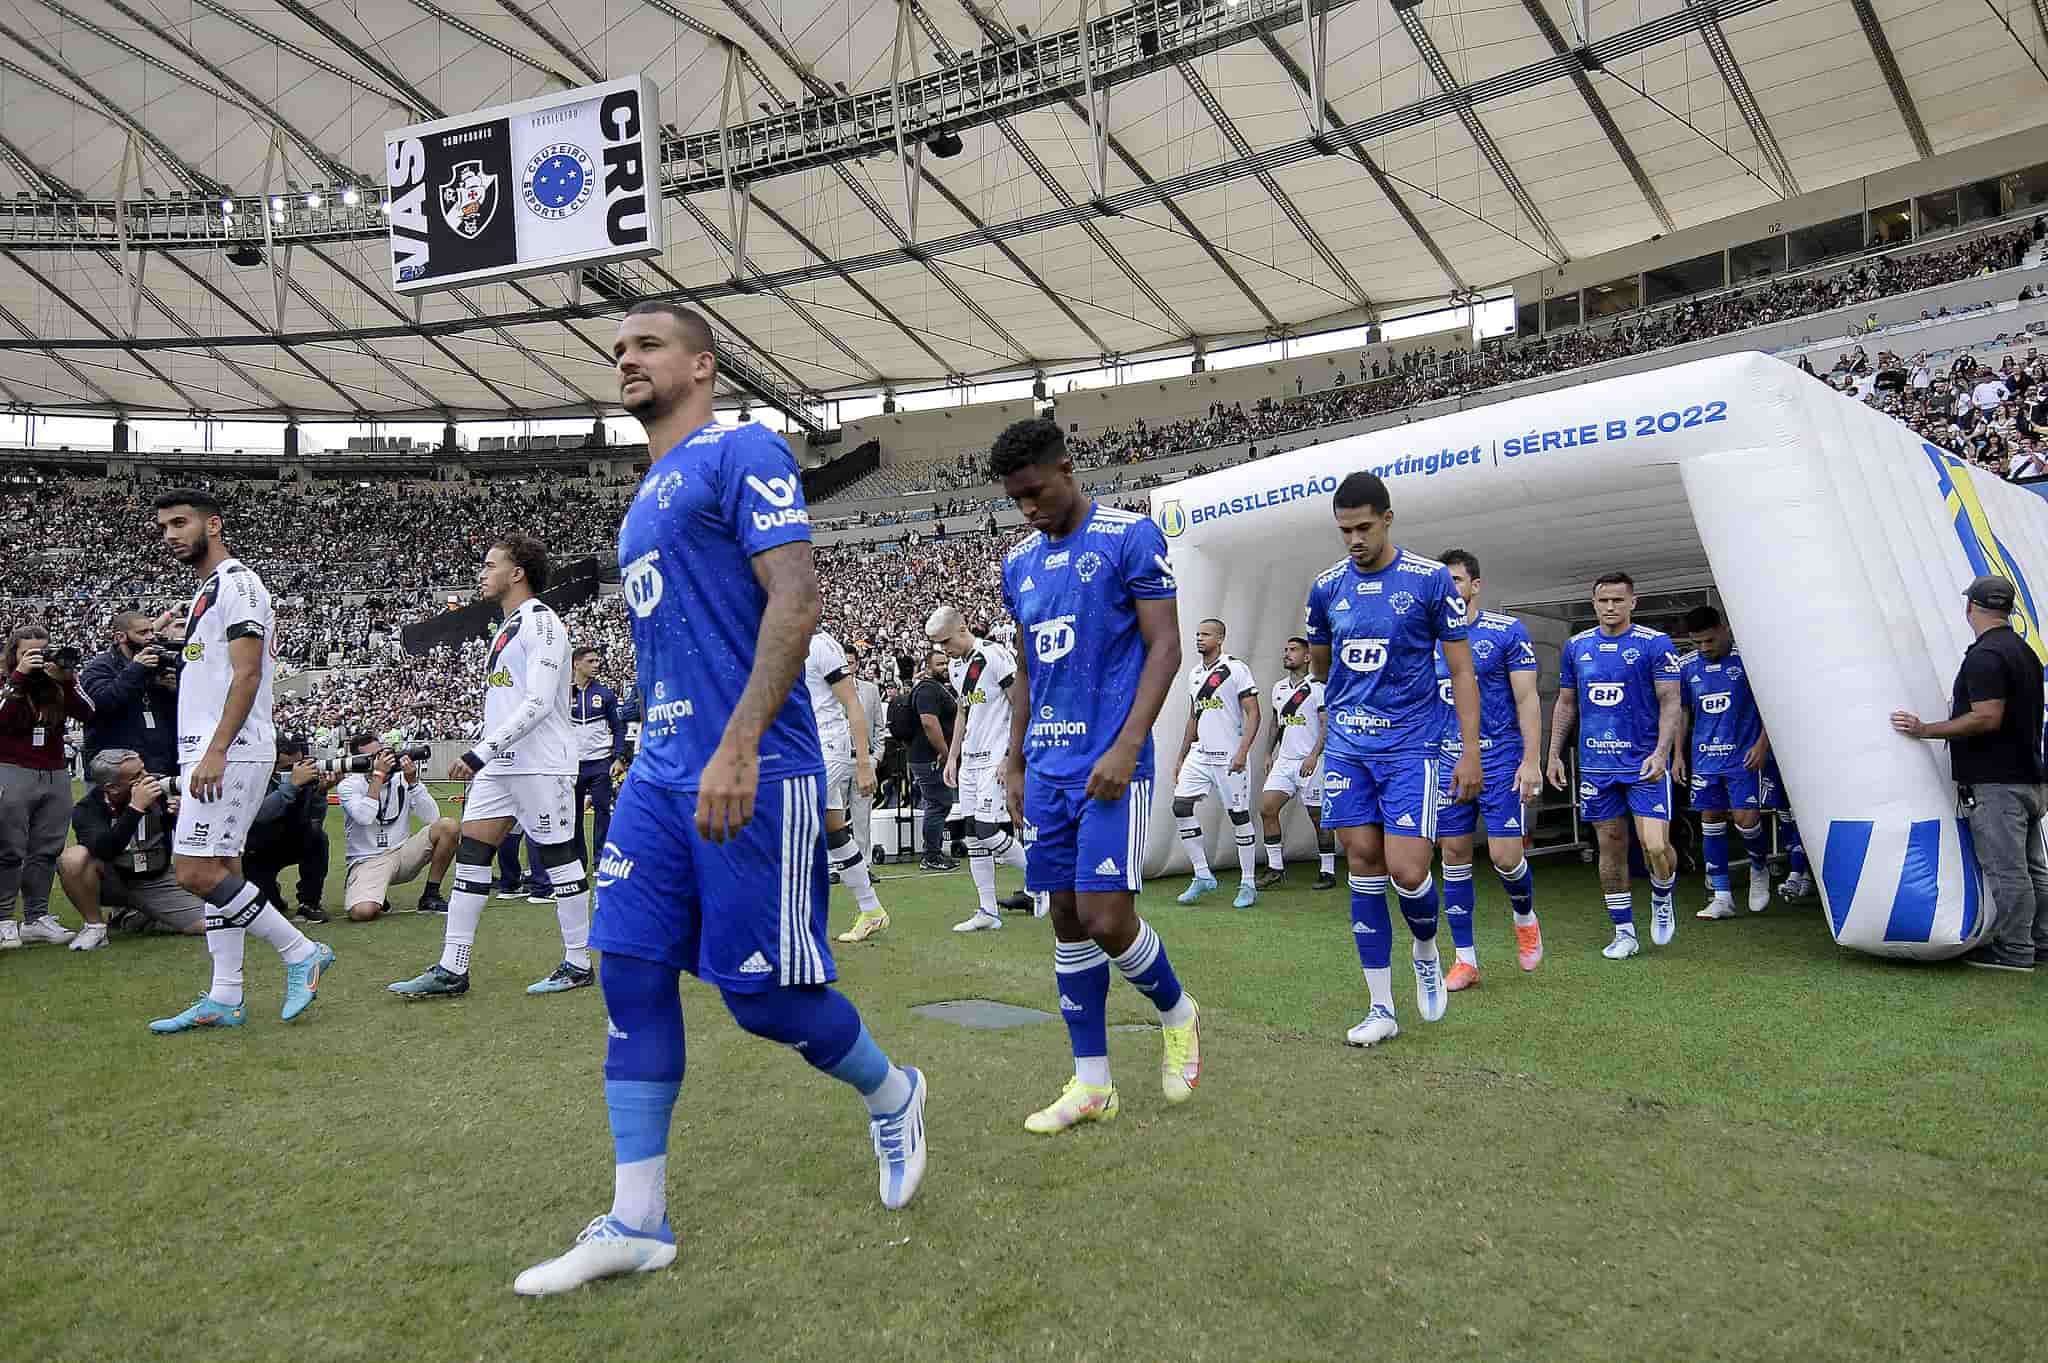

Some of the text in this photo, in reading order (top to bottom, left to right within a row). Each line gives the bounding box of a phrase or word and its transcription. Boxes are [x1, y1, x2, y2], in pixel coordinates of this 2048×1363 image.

[528, 145, 587, 173] CRUZEIRO
[599, 89, 648, 247] CRU
[388, 137, 430, 266] VAS
[523, 168, 593, 217] ESPORTE CLUBE
[1191, 400, 1727, 525] BRASILEIRÃO ortingbet SÉRIE B 2022
[752, 508, 809, 531] buse
[1348, 648, 1381, 664] BH
[1594, 689, 1619, 701] BH
